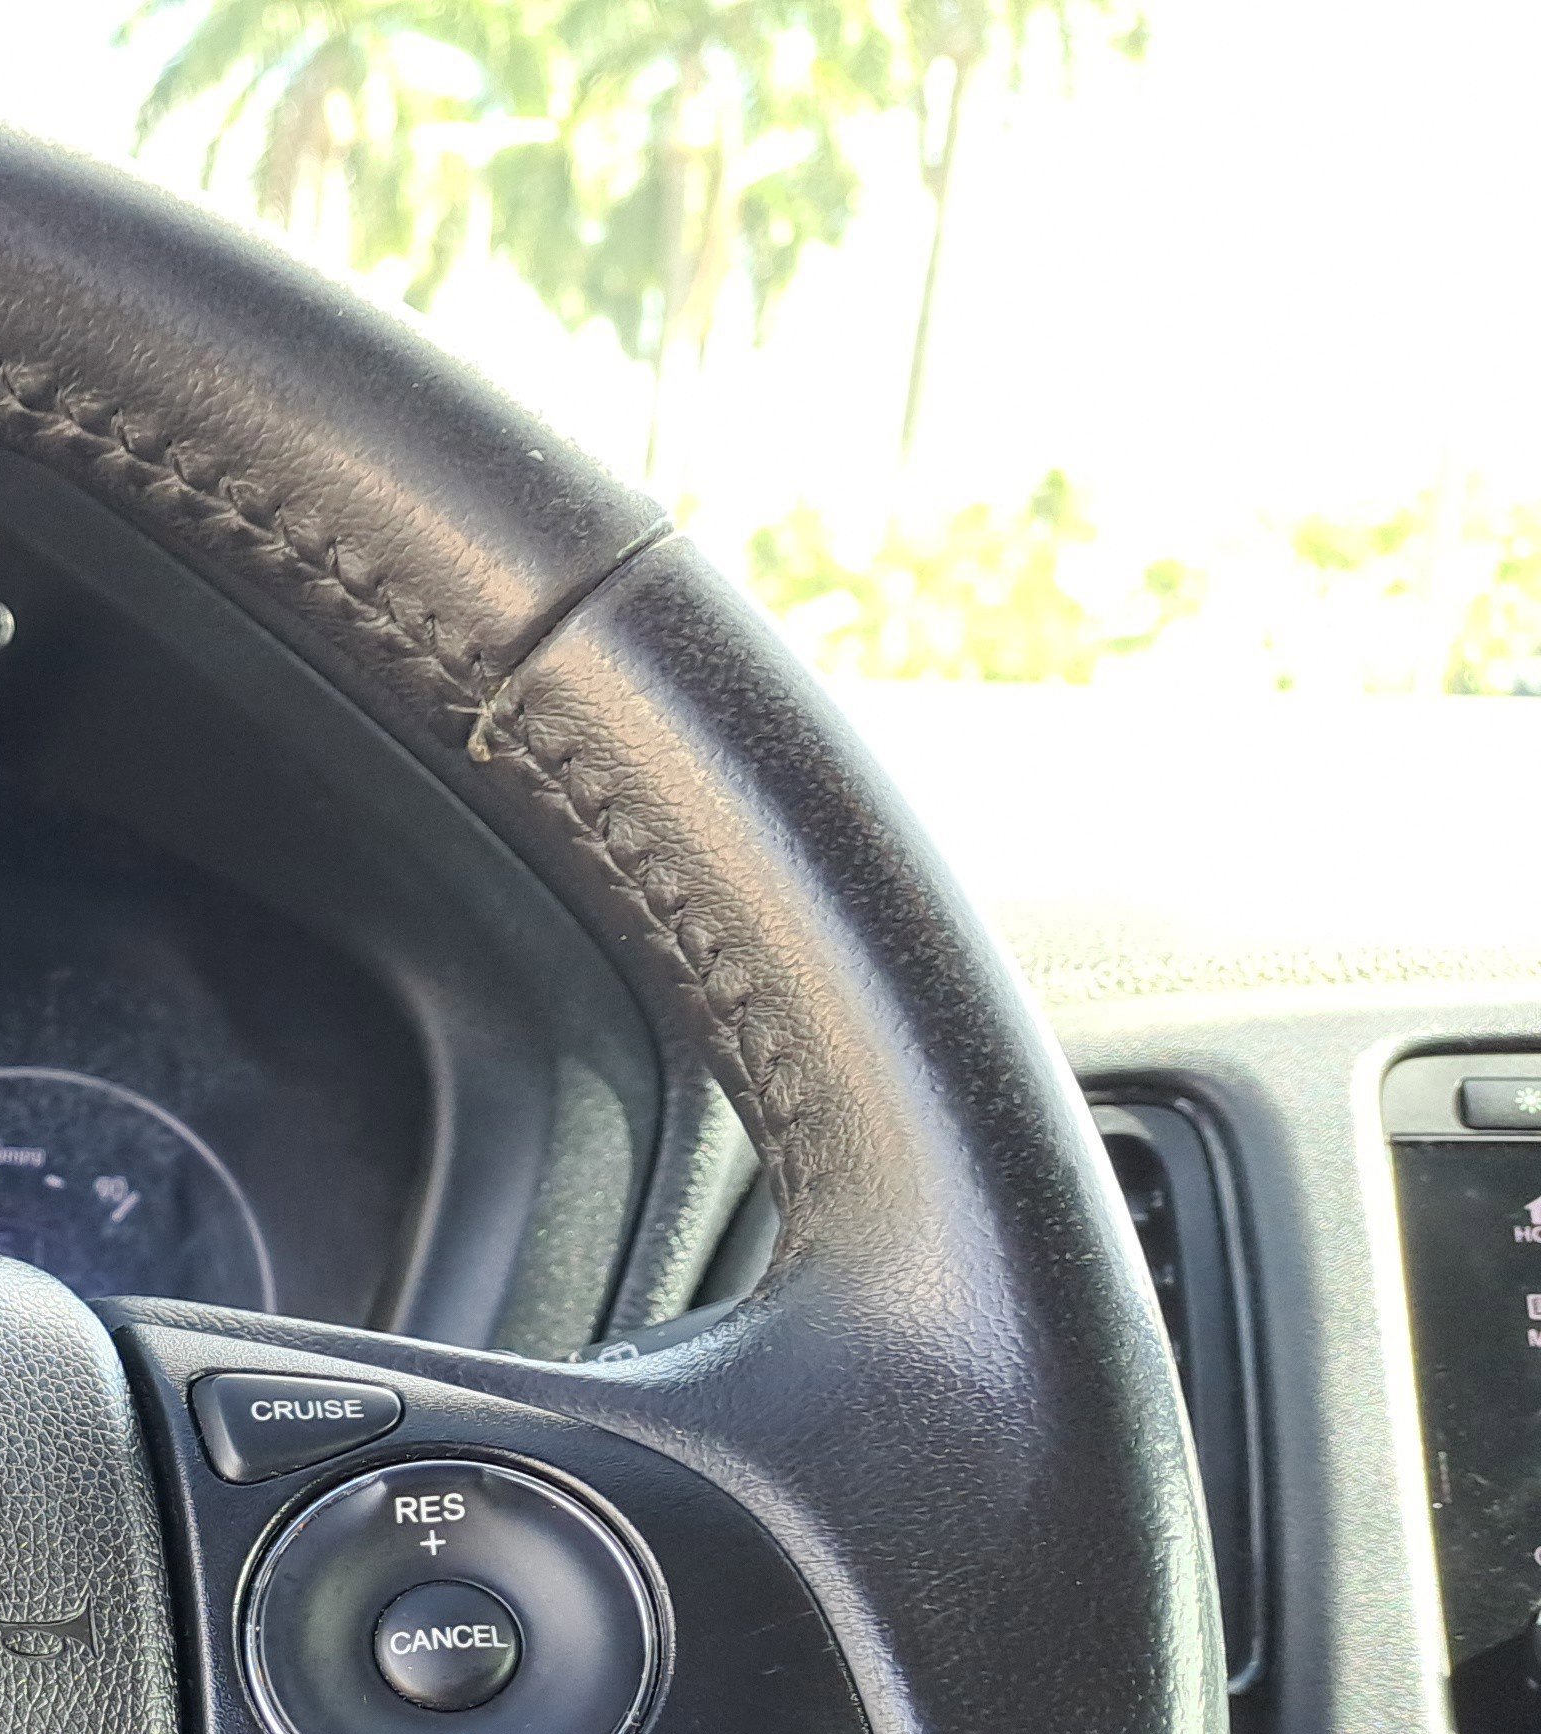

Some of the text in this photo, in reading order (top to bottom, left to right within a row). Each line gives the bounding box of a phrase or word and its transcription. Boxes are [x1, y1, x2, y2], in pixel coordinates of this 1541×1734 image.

[251, 1399, 365, 1421] CRUISE
[395, 1493, 465, 1524] RES
[390, 1625, 510, 1655] CANCEL
